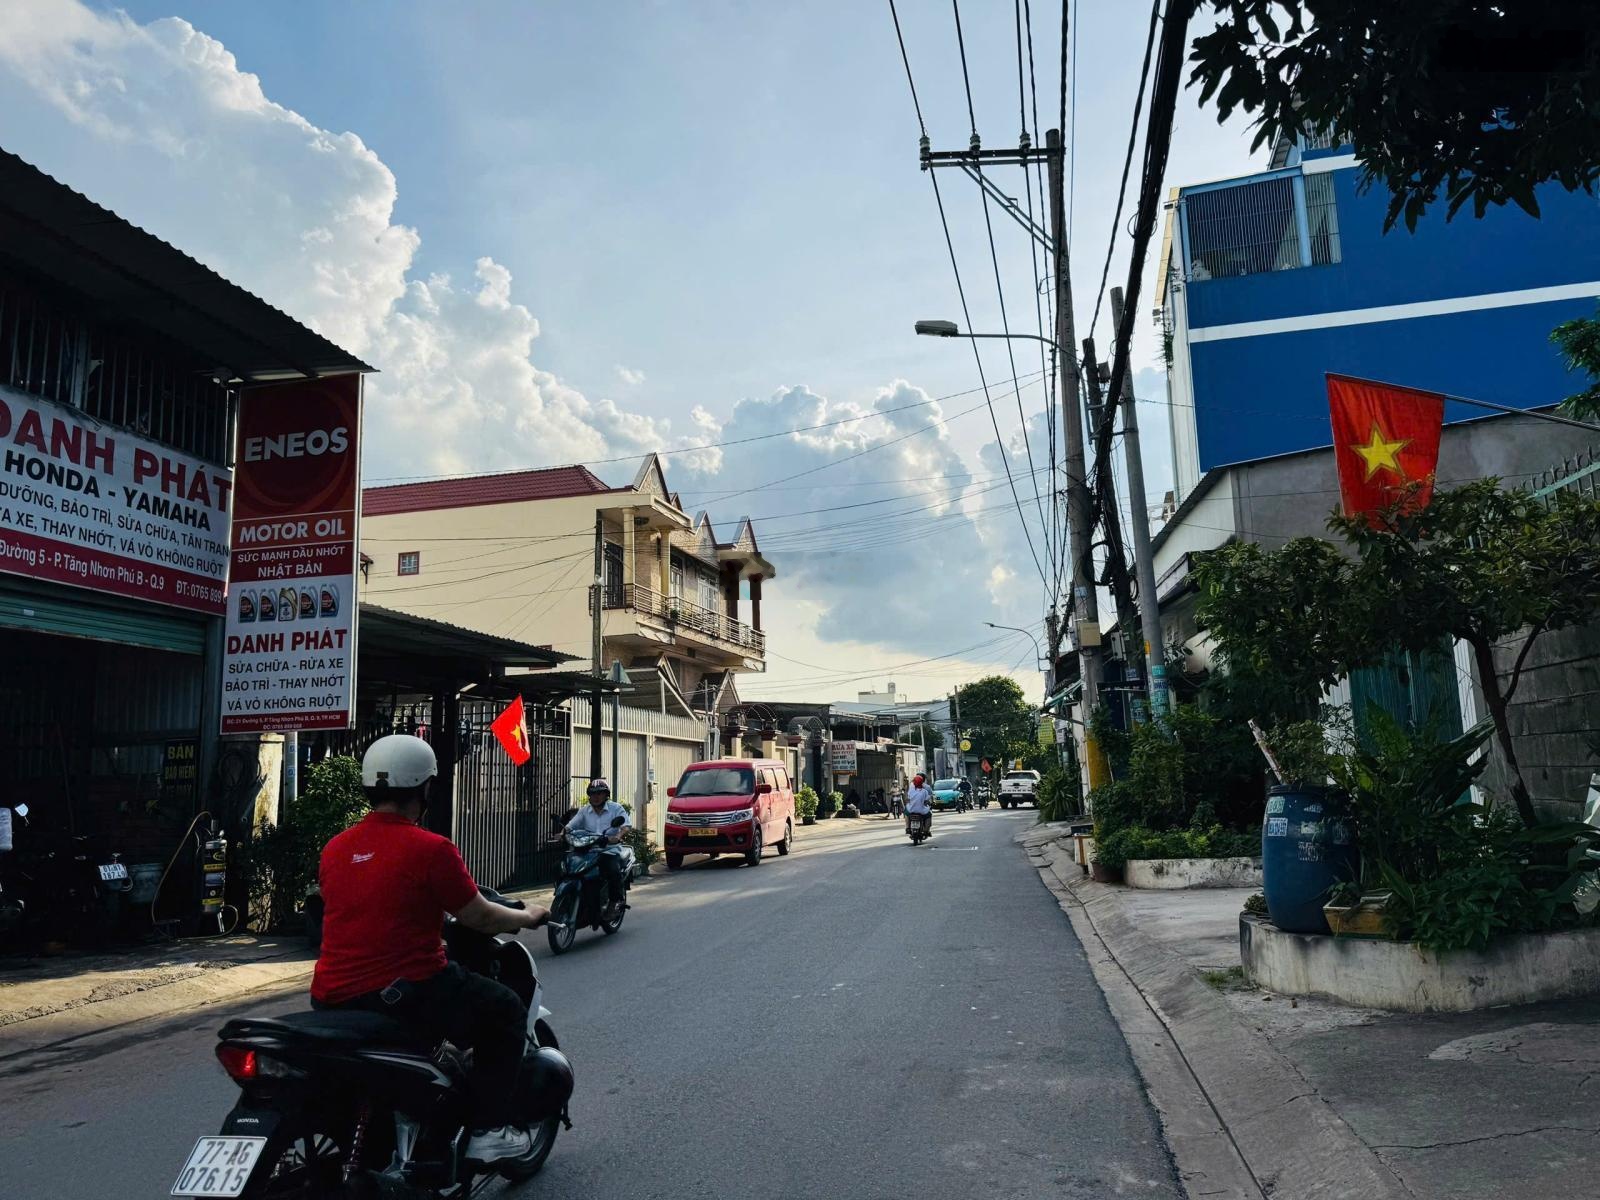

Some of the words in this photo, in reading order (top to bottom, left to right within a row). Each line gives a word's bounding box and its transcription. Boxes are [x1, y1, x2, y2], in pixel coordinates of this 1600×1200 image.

[244, 427, 349, 462] ENEOS
[5, 450, 100, 498] HONDA
[123, 486, 211, 532] YAMAHA
[134, 448, 232, 512] PHÁT
[61, 498, 89, 518] BẢO
[92, 507, 113, 528] TRÌ,
[117, 513, 142, 534] SỬA
[145, 523, 180, 546] CHỮA,
[239, 521, 309, 543] MOTOR
[314, 518, 346, 537] OIL
[0, 507, 12, 523] A
[16, 511, 37, 532] XE,
[41, 517, 75, 538] THAY
[78, 528, 116, 551] NHỚT,
[120, 537, 135, 554] VÁ
[138, 541, 153, 558] VỎ
[156, 548, 194, 569] KHÔNG
[196, 558, 224, 576] RUỘT
[237, 552, 259, 563] SỨC
[261, 550, 290, 562] MẠNH
[292, 547, 314, 559] DẦU
[315, 545, 346, 557] NHỚT
[39, 549, 45, 564] 5
[90, 560, 116, 580] Nhơn
[117, 566, 135, 584] Phú
[137, 571, 144, 585] B
[150, 574, 165, 590] Q.9
[257, 564, 293, 579] NHẬT
[295, 561, 323, 575] BẢN
[227, 633, 284, 655] DANH
[291, 627, 348, 651] PHÁT
[228, 660, 253, 674] SỬA
[256, 659, 290, 672] CHỮA
[299, 656, 325, 670] RỬA
[328, 658, 344, 669] XE
[225, 678, 249, 691] BẢO
[252, 677, 269, 690] TRÌ
[278, 678, 308, 689] THAY
[311, 674, 345, 687] NHỚT
[227, 697, 242, 711] VÁ
[245, 696, 261, 710] VỎ
[263, 695, 305, 709] KHÔNG
[309, 693, 342, 709] RUỘT
[198, 1141, 254, 1166] 77-AG
[179, 1167, 249, 1192] 076.15
